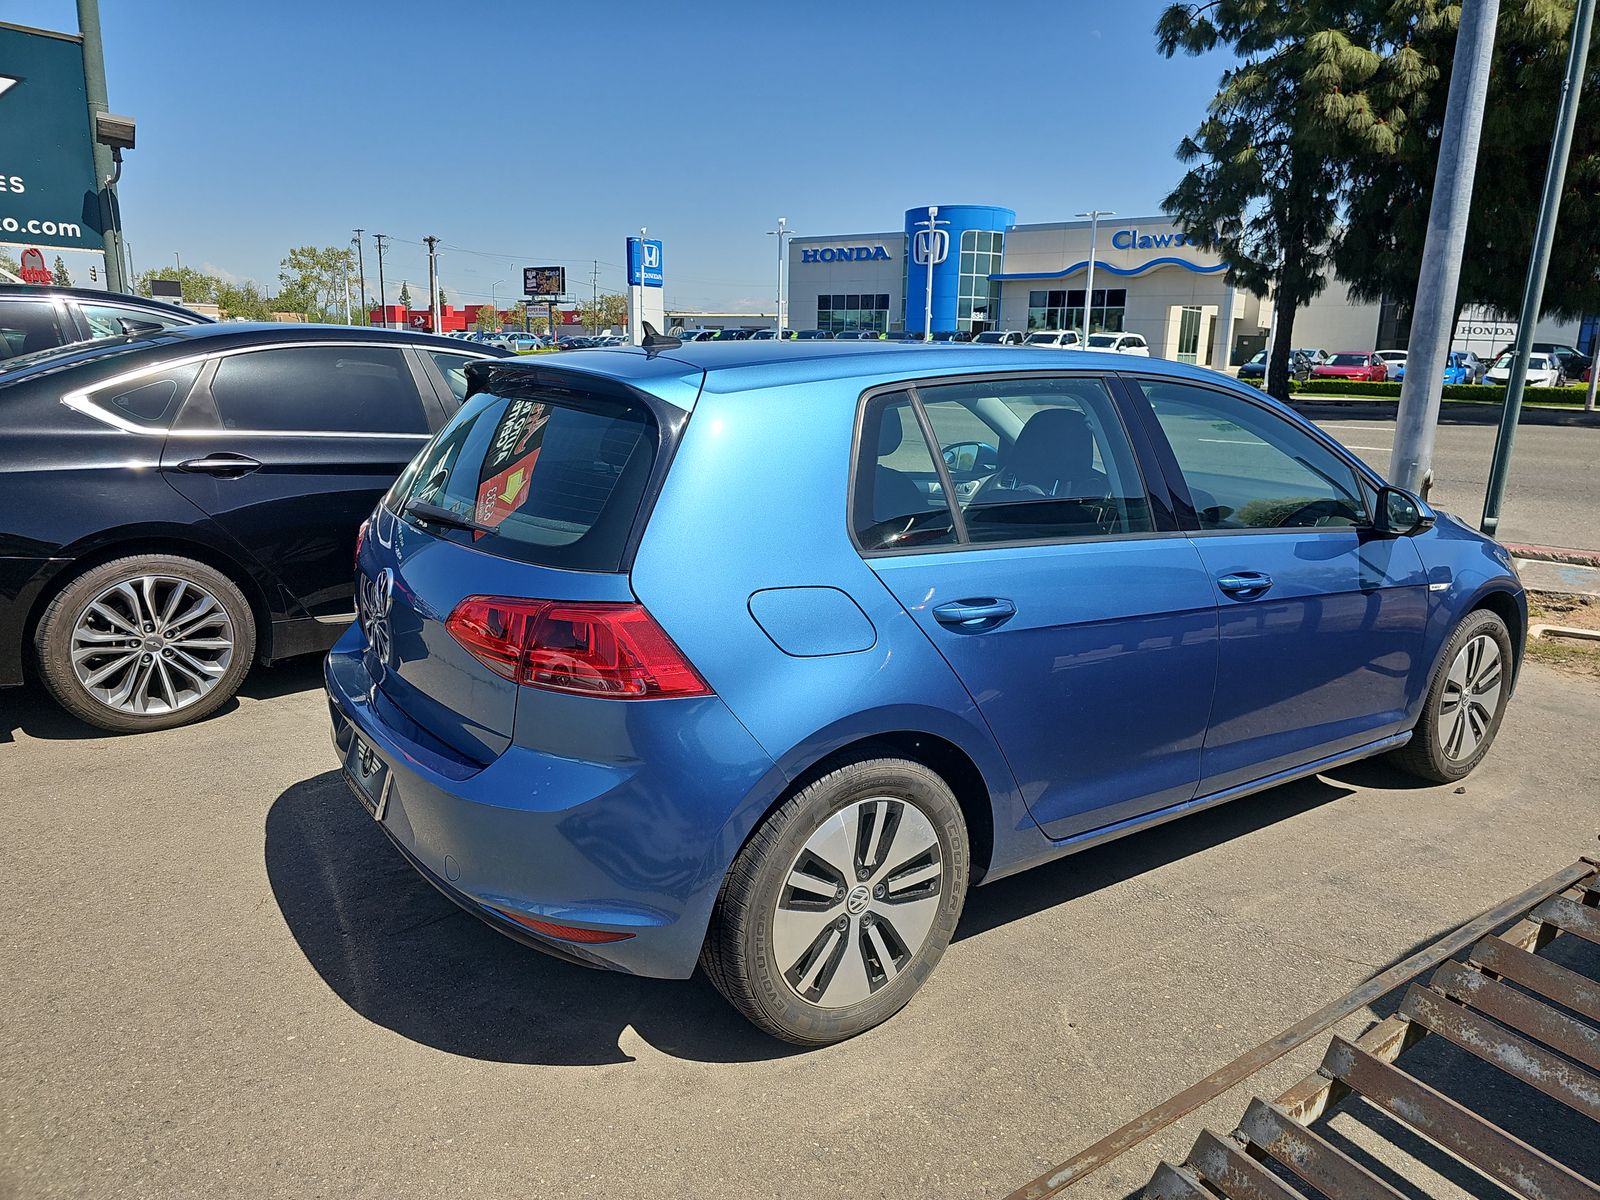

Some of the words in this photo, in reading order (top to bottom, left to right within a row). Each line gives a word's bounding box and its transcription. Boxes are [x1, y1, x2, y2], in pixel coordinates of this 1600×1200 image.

[0, 217, 81, 238] o.com
[801, 246, 891, 263] HONDA
[1461, 326, 1515, 336] HONDA
[948, 822, 964, 912] COOPER
[754, 906, 787, 1011] EVOLUTION
